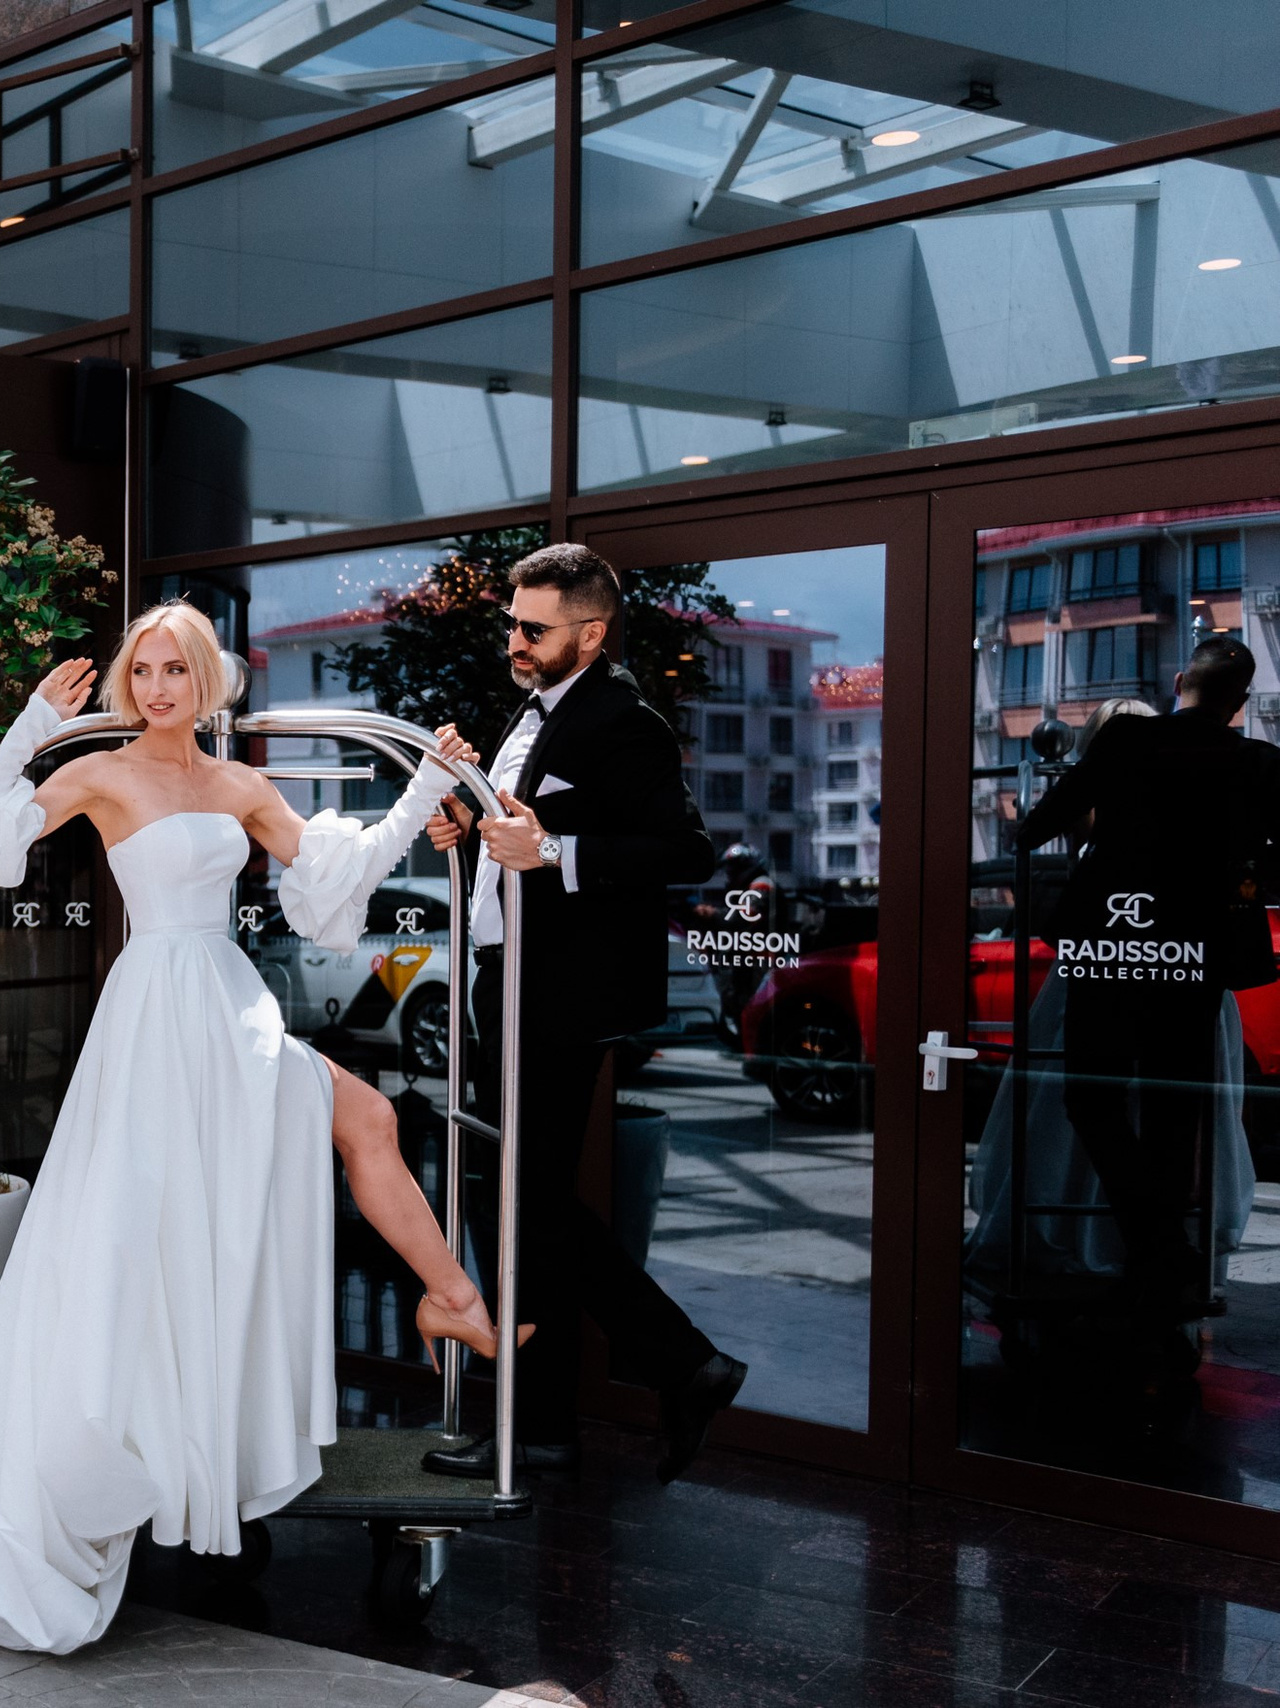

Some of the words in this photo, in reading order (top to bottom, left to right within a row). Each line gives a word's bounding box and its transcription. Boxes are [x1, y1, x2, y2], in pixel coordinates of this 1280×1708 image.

[687, 930, 800, 953] RADISSON
[1058, 939, 1204, 964] RADISSON
[686, 953, 800, 969] COLLECTION
[1057, 965, 1204, 982] COLLECTION
